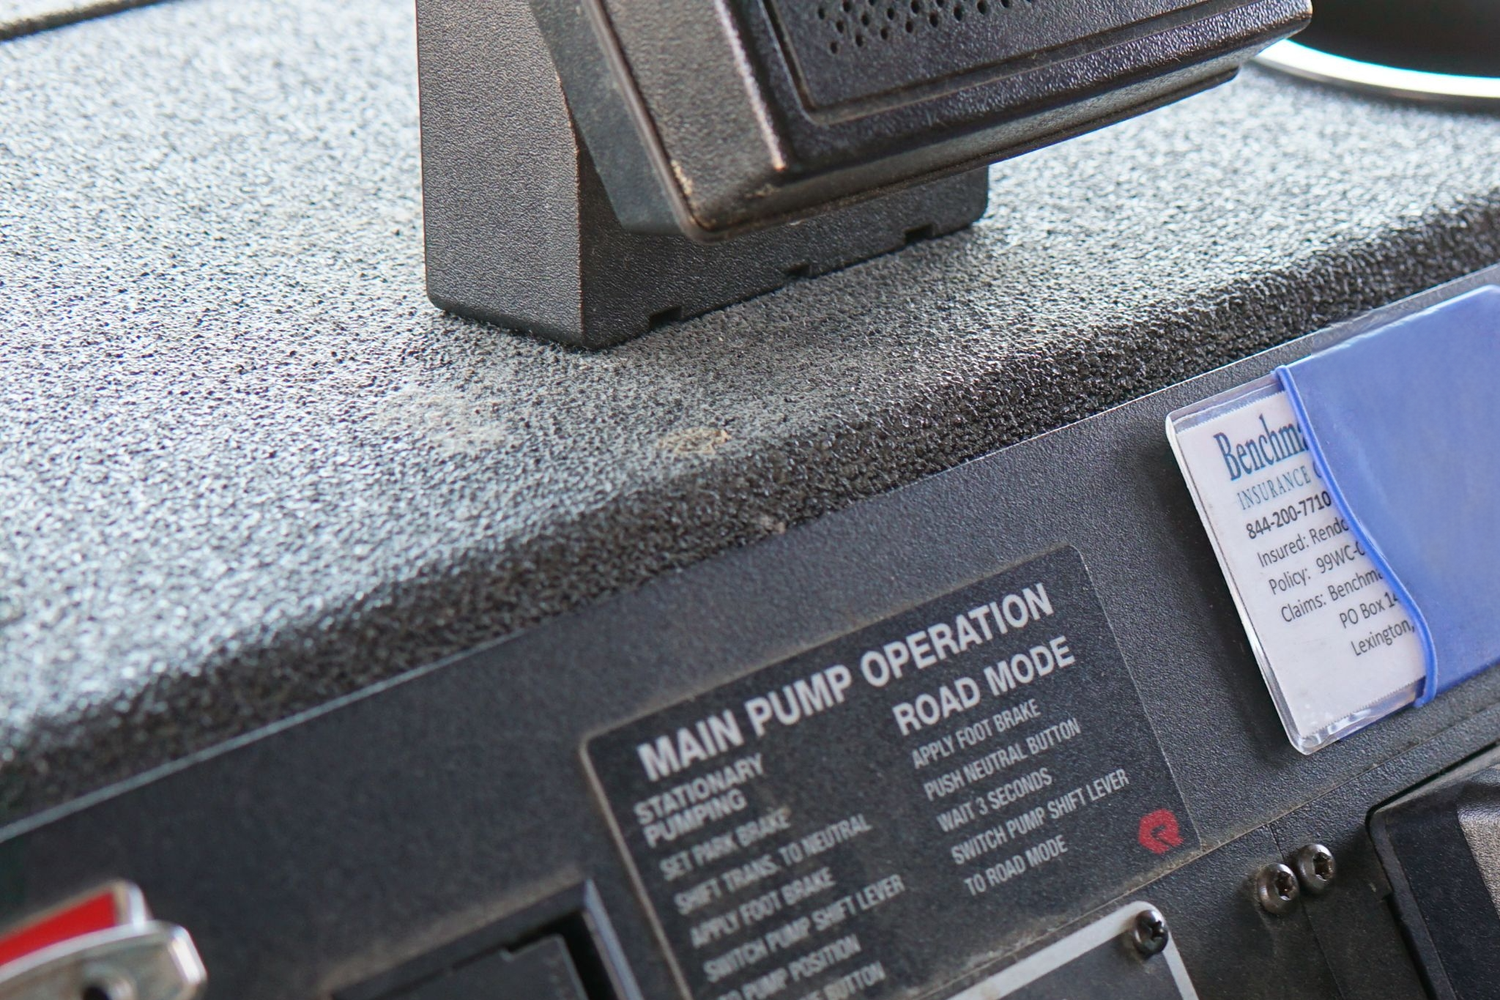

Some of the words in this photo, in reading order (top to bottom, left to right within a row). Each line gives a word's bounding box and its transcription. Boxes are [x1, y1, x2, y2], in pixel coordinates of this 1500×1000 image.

[1236, 464, 1312, 511] INSURANCE
[1245, 490, 1332, 540] 844-200-7710
[1257, 534, 1311, 568] Insured:
[1268, 566, 1312, 595] Policy:
[1280, 593, 1327, 623] Claims:
[1339, 605, 1359, 629] PO
[1359, 599, 1385, 621] Box
[1350, 617, 1416, 657] Lexington,
[637, 711, 745, 782] MAIN
[744, 664, 853, 736] PUMP
[861, 582, 1054, 689] OPERATION
[892, 676, 982, 737] ROAD
[983, 636, 1076, 701] MODE
[911, 735, 955, 769] APPLY
[955, 719, 993, 750] FOOT
[993, 698, 1042, 733] BRAKE
[923, 773, 965, 802] PUSH
[963, 740, 1028, 783] NEUTRAL
[1025, 716, 1081, 754] BUTTON
[633, 752, 766, 826] STATIONARY
[642, 788, 747, 848] PUMPING
[936, 804, 977, 833] WAIT
[978, 797, 989, 816] 3
[988, 767, 1053, 810] SECONDS
[951, 825, 1006, 865] SWITCH
[1005, 806, 1047, 838] PUMP
[1048, 789, 1087, 820] SHIFT
[1086, 768, 1130, 803] LEVER
[660, 851, 693, 882] SET
[691, 832, 738, 867] PARK
[735, 806, 791, 847] BRAKE
[674, 878, 721, 916] SHIFT
[779, 844, 803, 867] TO
[801, 813, 873, 857] NEUTRAL
[963, 873, 987, 897] TO
[985, 854, 1027, 887] ROAD
[1026, 834, 1069, 867] MODE
[690, 911, 740, 949] APPLY
[739, 890, 782, 925] FOOT
[781, 866, 836, 905] BRAKE
[703, 937, 769, 983] SWITCH
[765, 916, 811, 952] PUMP
[811, 895, 857, 931] SHIFT
[855, 873, 905, 911] LEVER
[788, 933, 862, 981] POSITION
